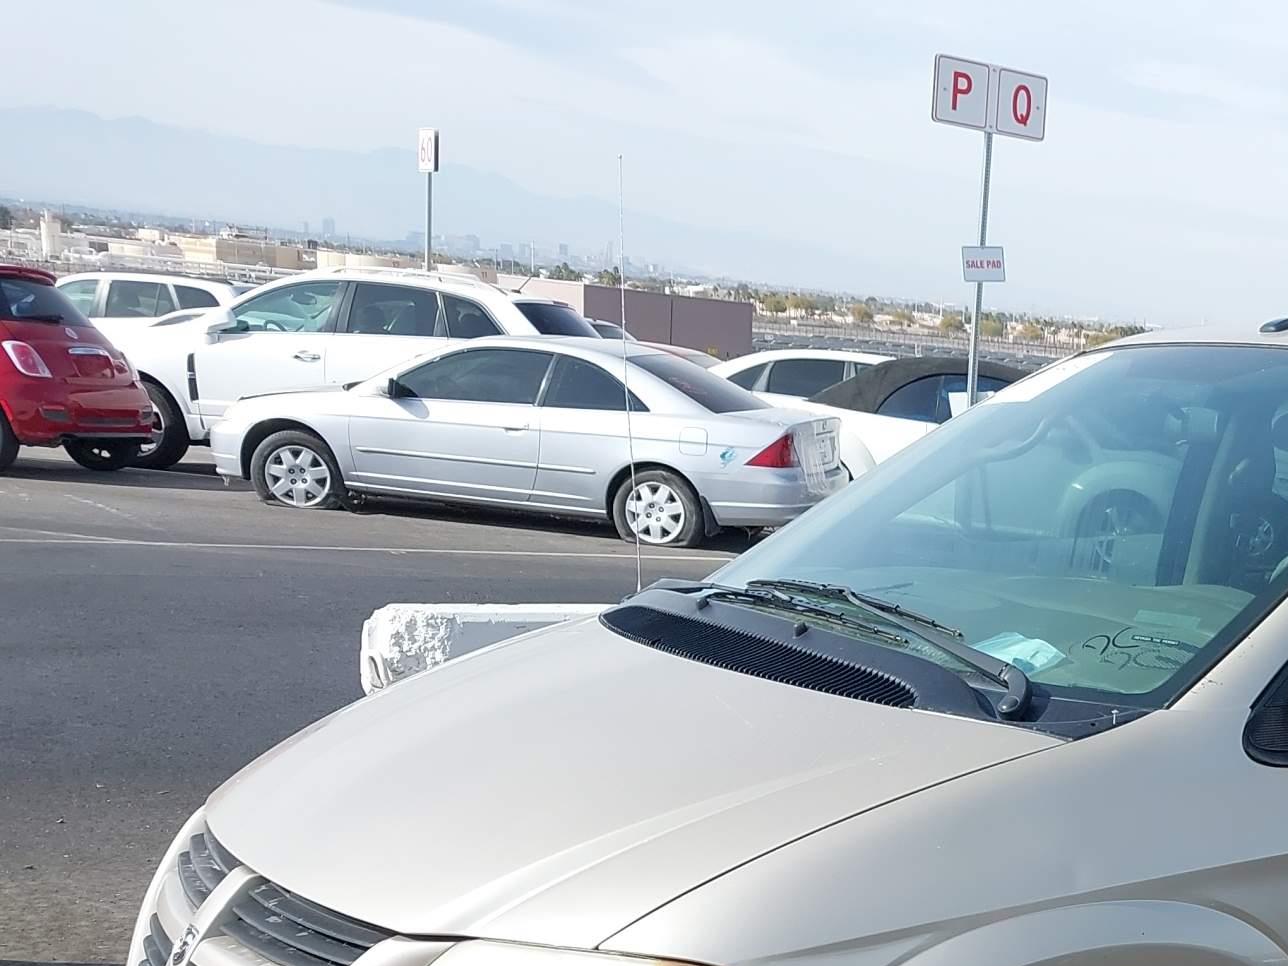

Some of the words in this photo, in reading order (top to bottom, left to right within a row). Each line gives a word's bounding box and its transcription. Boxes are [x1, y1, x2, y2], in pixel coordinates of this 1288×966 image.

[951, 70, 973, 111] P
[1012, 84, 1032, 126] Q
[965, 259, 985, 269] SALE
[986, 259, 1002, 269] PAD
